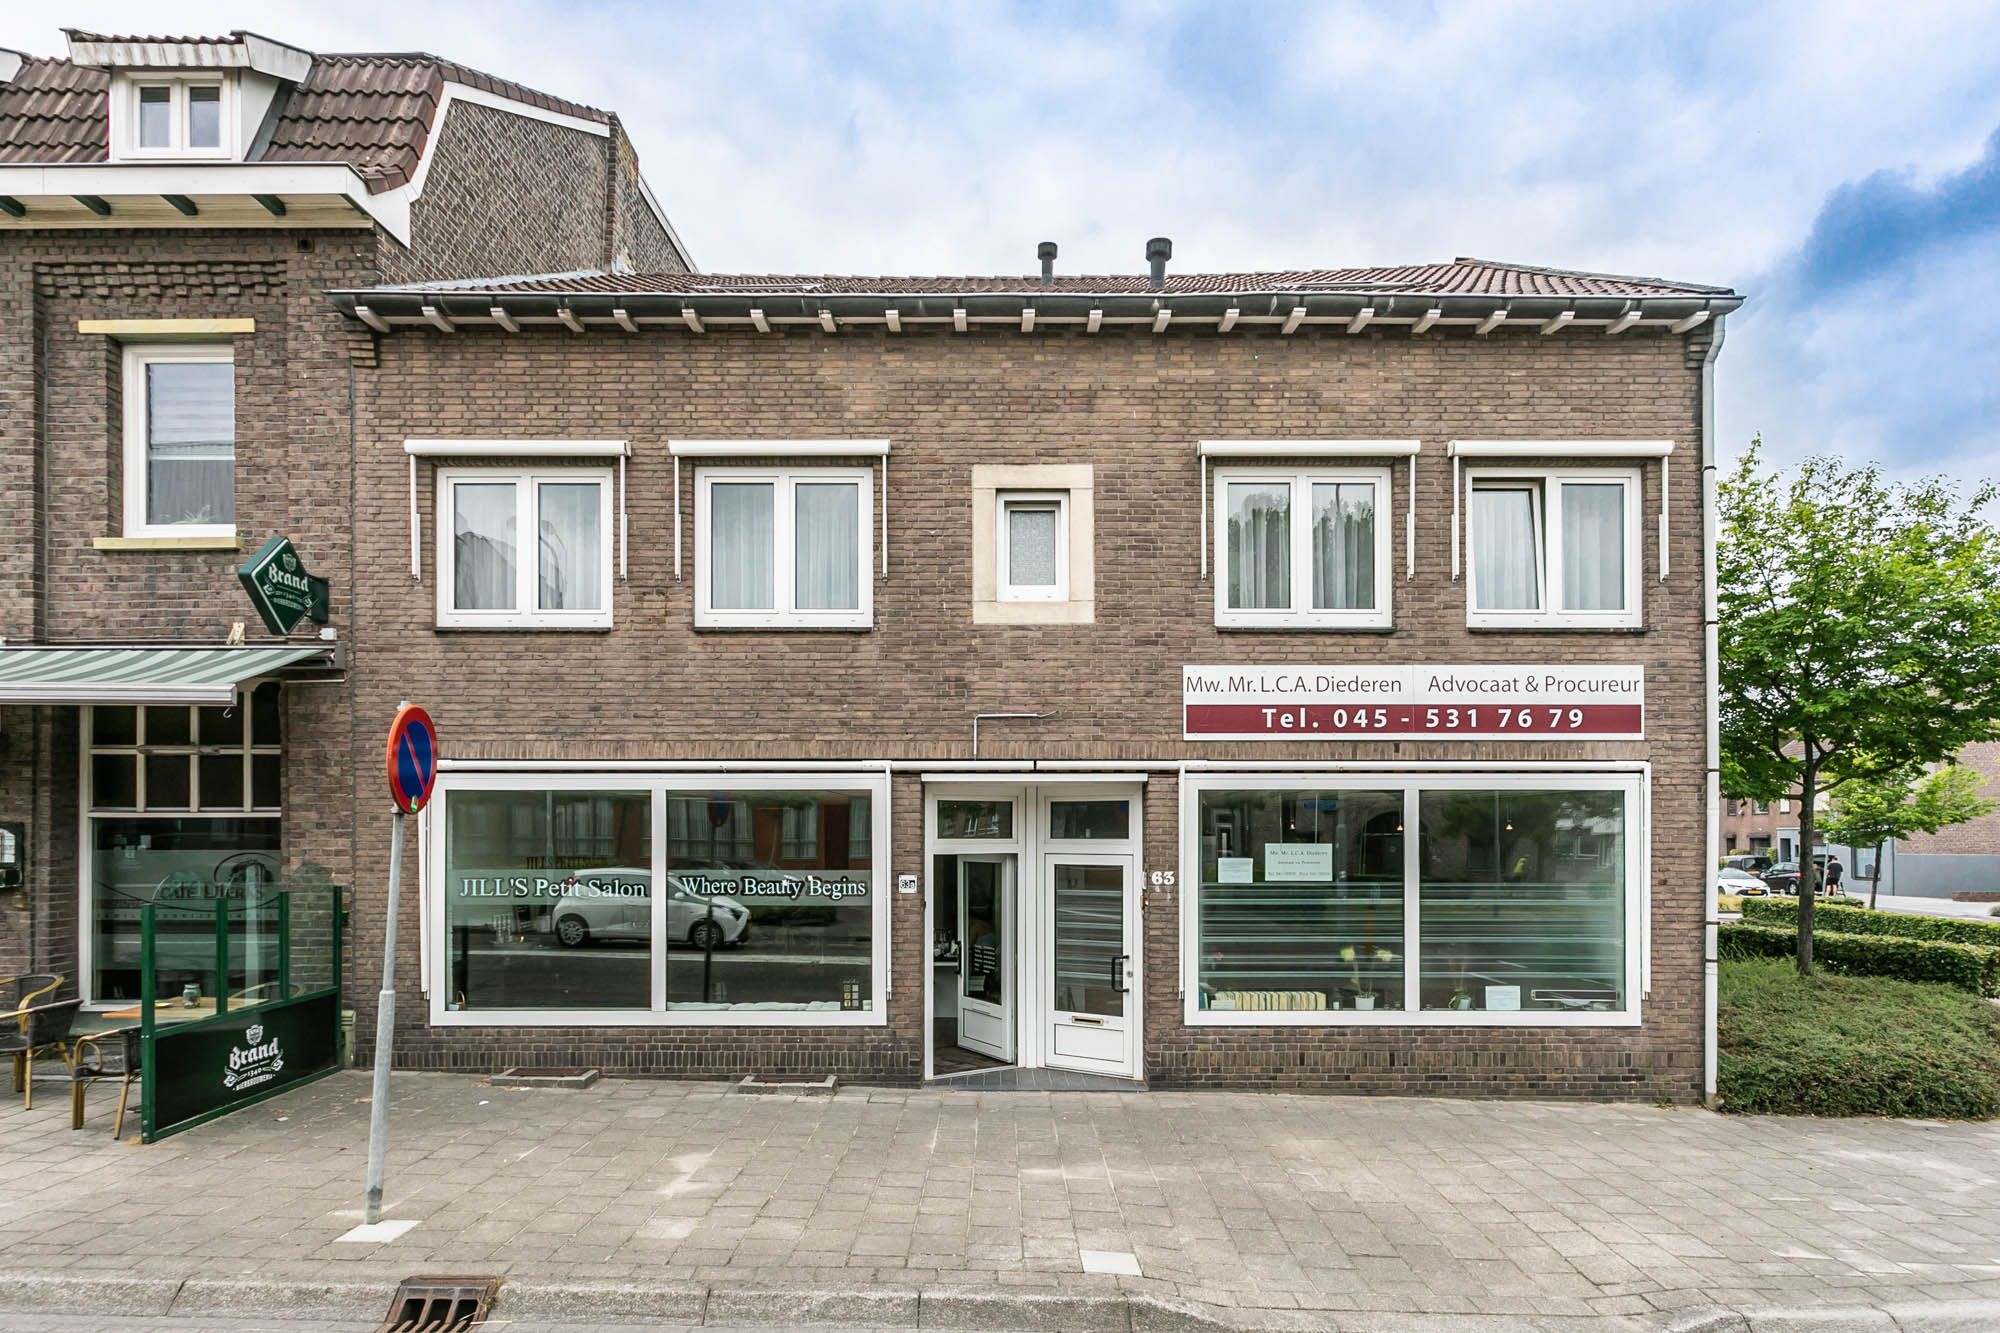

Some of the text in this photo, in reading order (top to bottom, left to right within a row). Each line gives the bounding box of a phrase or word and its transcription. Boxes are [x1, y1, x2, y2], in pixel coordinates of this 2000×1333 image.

[268, 562, 309, 592] Brand
[1186, 675, 1640, 693] Mw. Mr. L.C.A. Diederen Advocaat & Procureur
[1261, 707, 1319, 728] Tel.
[1333, 708, 1387, 728] 045
[1425, 708, 1478, 728] 531
[1498, 708, 1533, 728] 76
[1549, 708, 1584, 728] 79
[459, 876, 866, 899] JILL'S Petit Salon Where Beauty Begins
[1151, 871, 1175, 885] 63
[228, 1037, 279, 1070] Brand
